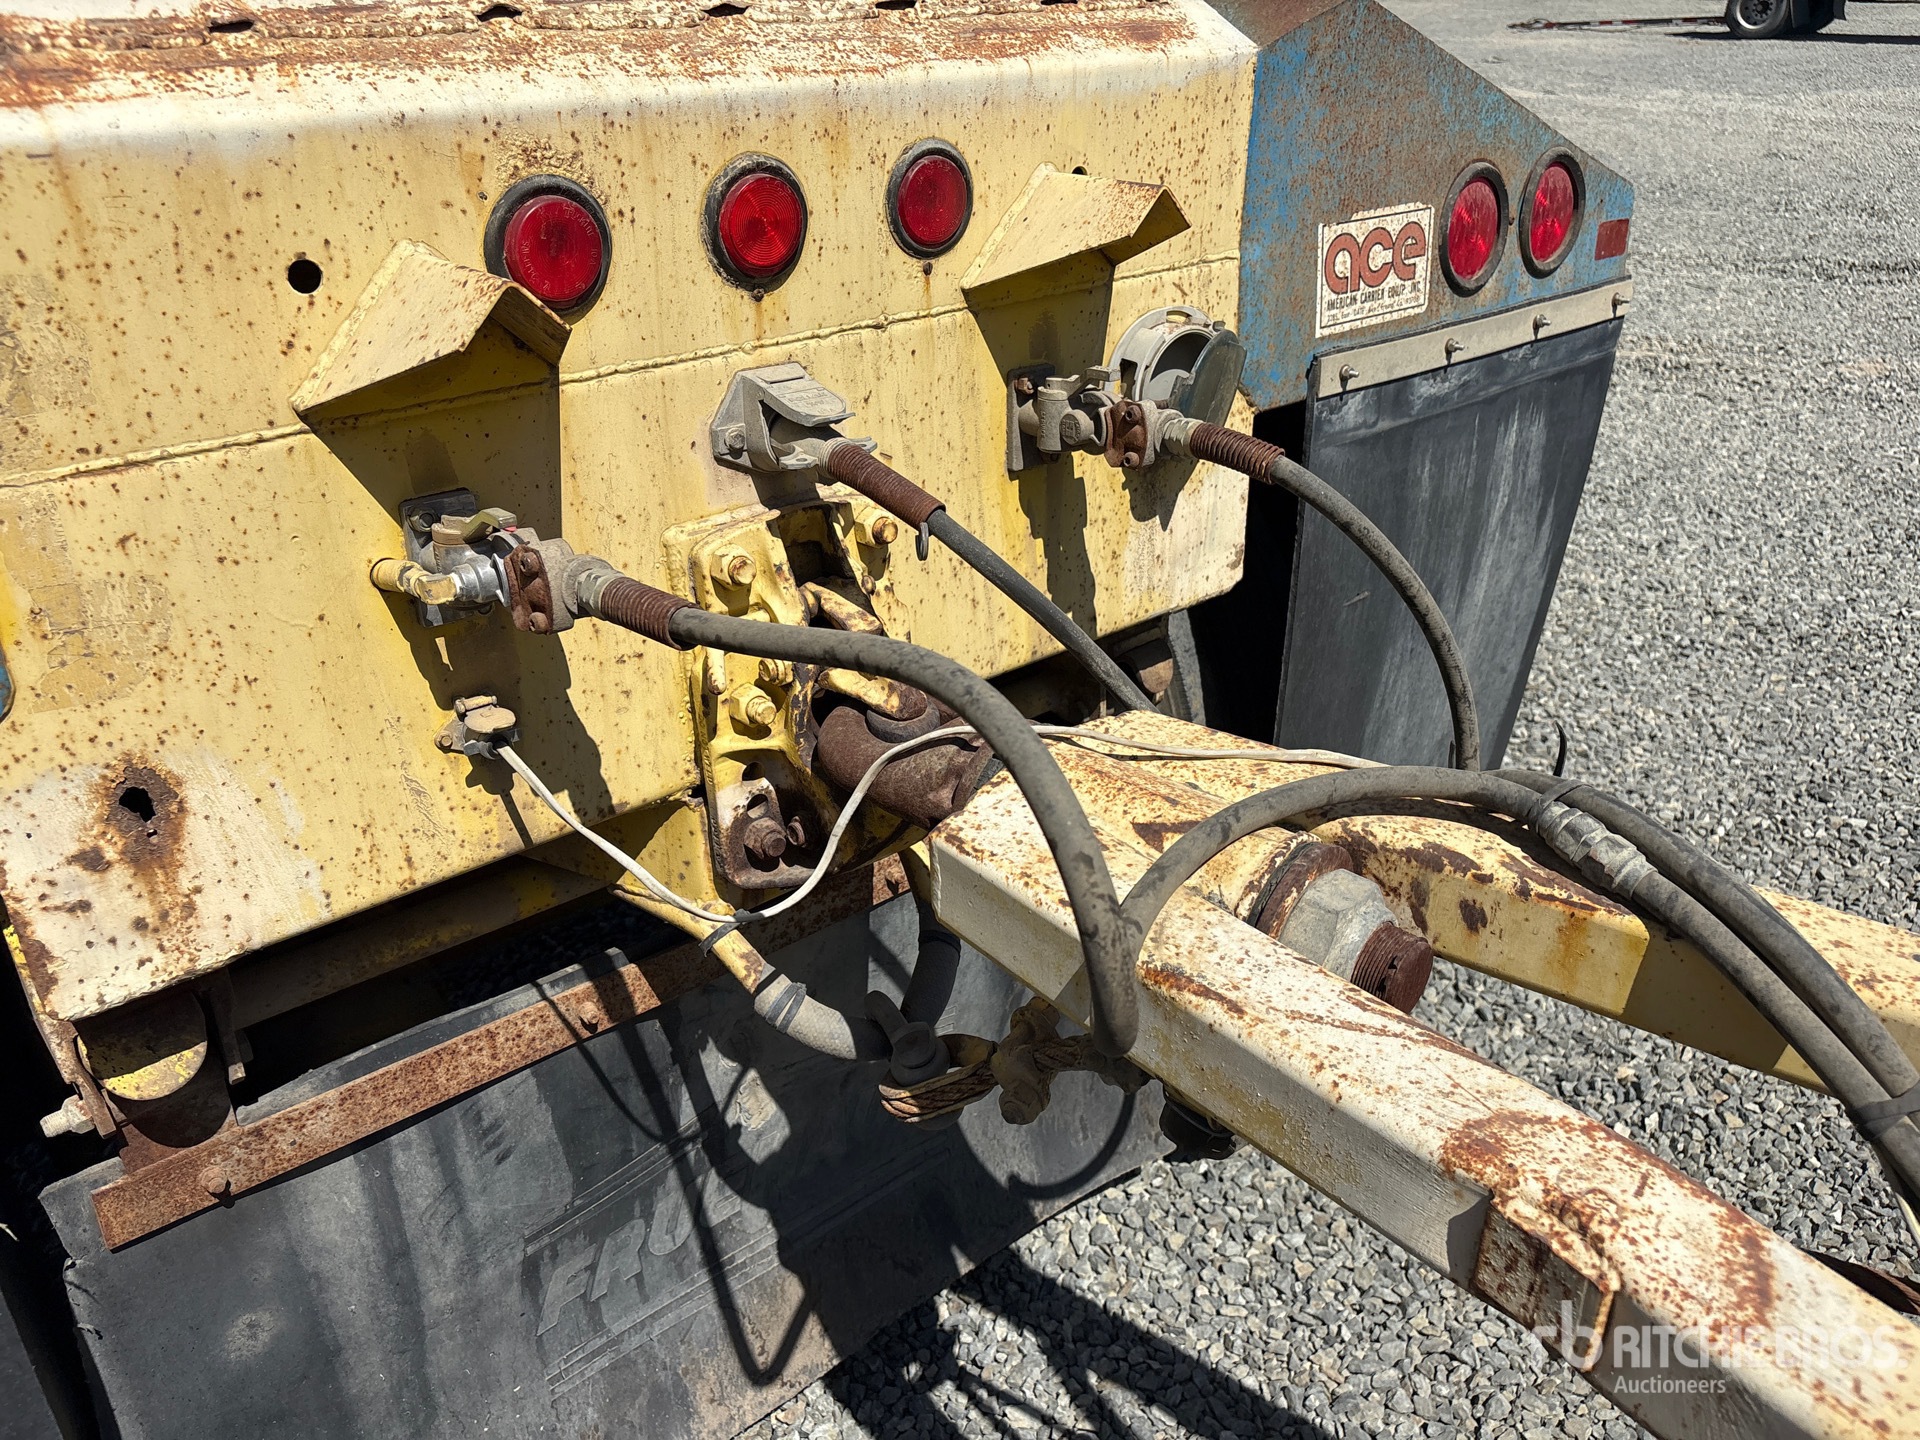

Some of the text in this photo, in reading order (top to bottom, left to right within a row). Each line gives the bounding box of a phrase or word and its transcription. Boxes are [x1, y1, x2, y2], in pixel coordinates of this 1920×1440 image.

[1325, 221, 1427, 295] ace
[1327, 294, 1357, 311] AMERICAN
[1360, 287, 1385, 304] CARRIER
